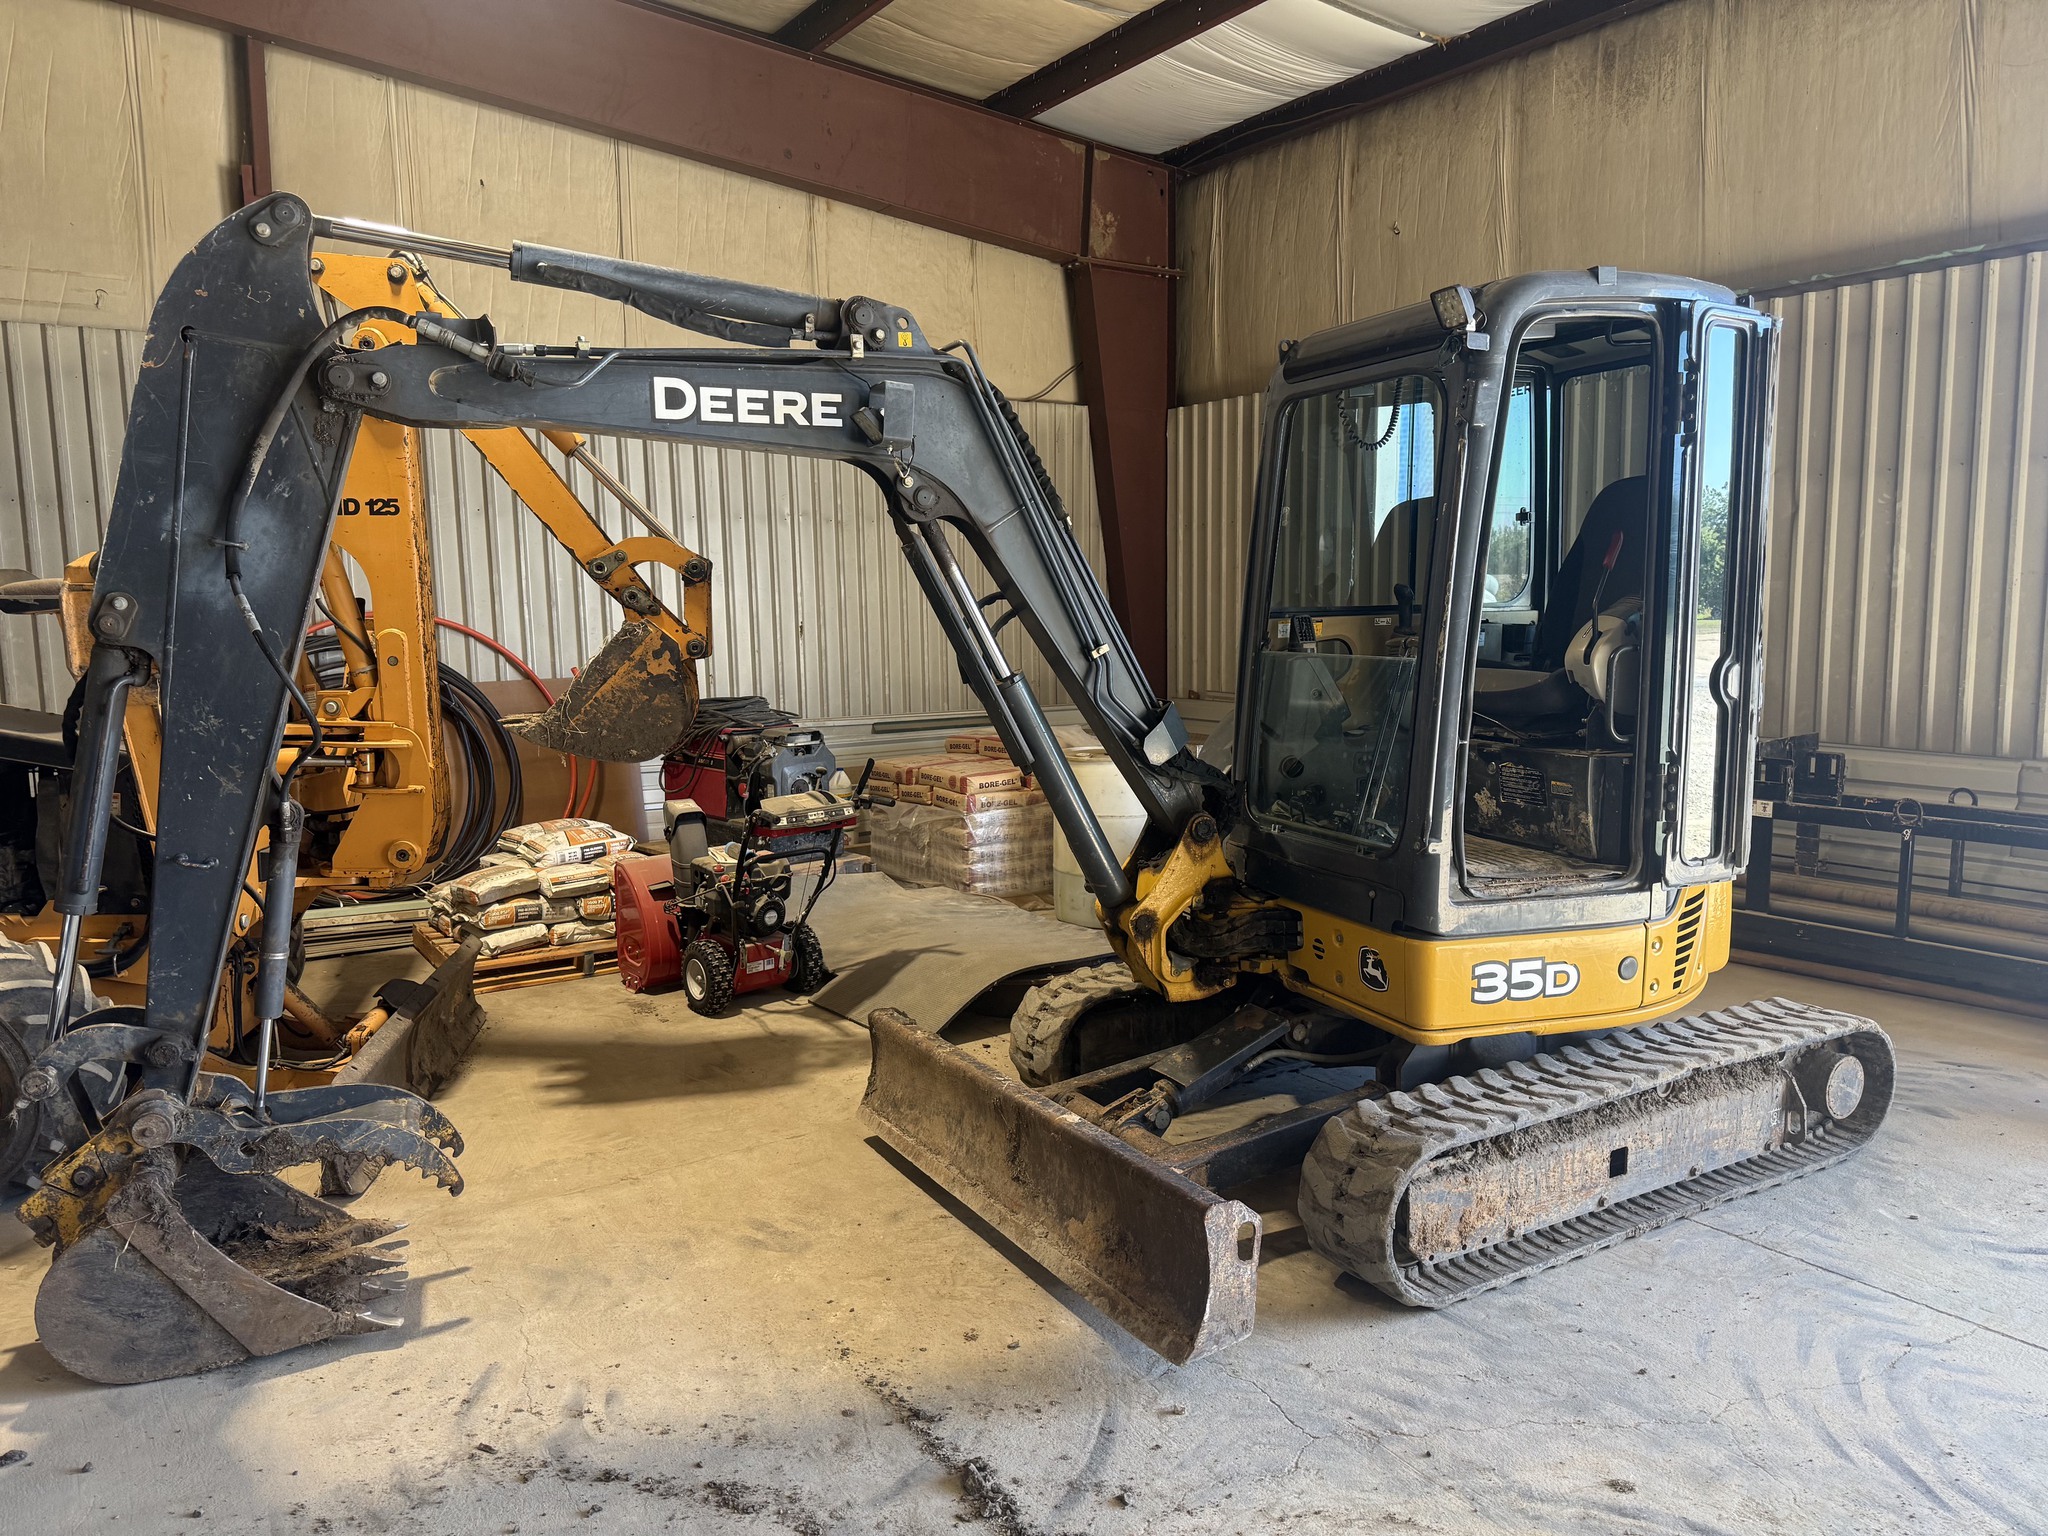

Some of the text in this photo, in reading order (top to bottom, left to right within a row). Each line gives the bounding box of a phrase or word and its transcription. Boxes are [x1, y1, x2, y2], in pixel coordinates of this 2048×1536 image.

[653, 377, 843, 428] DEERE
[365, 498, 400, 516] 125
[949, 742, 972, 750] BORE-GEL
[920, 772, 944, 783] BORE-GEL
[978, 777, 1018, 790] BORE-GEL
[869, 785, 891, 793] BORE-GEL
[901, 790, 924, 799] BORE-GEL
[935, 794, 960, 807] BORE-GEL
[1471, 957, 1580, 1004] 35D
